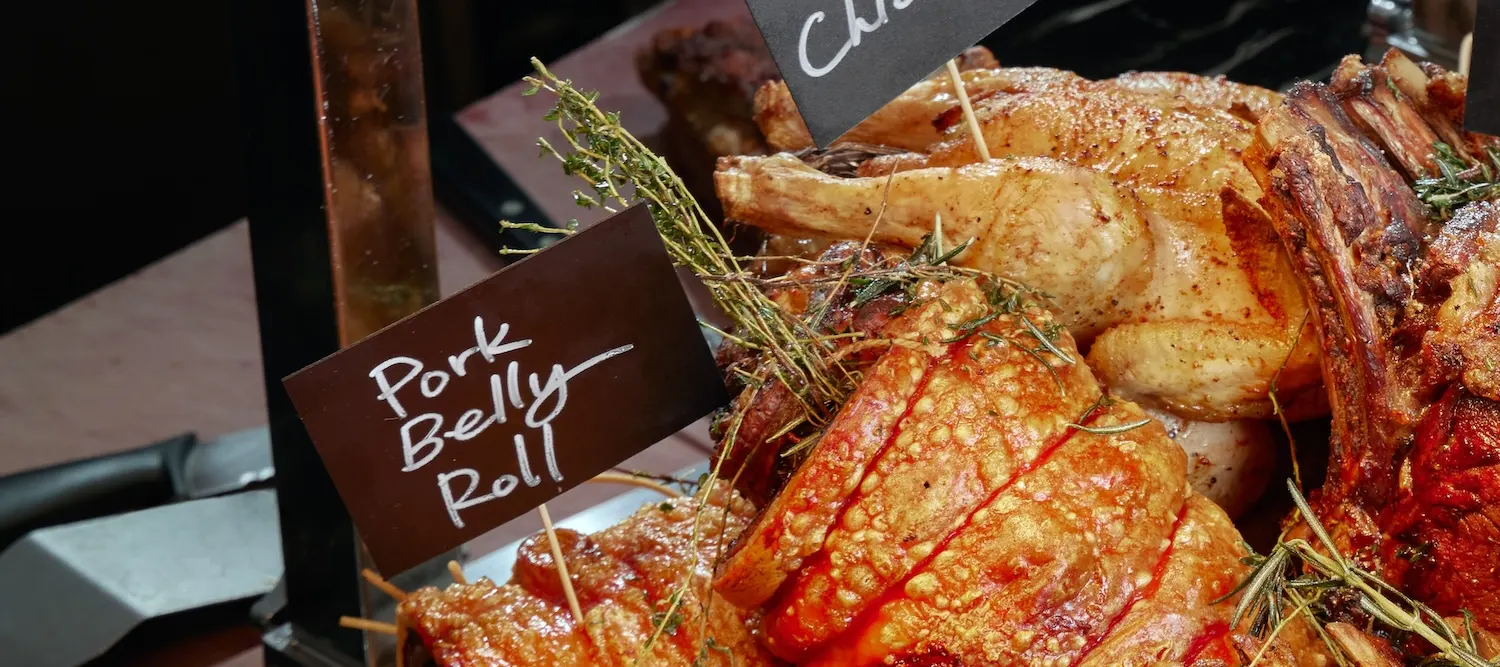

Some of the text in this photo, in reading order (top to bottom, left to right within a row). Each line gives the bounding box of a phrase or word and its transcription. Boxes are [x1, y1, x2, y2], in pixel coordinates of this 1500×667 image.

[368, 315, 533, 418] Pork
[400, 344, 635, 472] Belly
[437, 422, 564, 529] Roll
